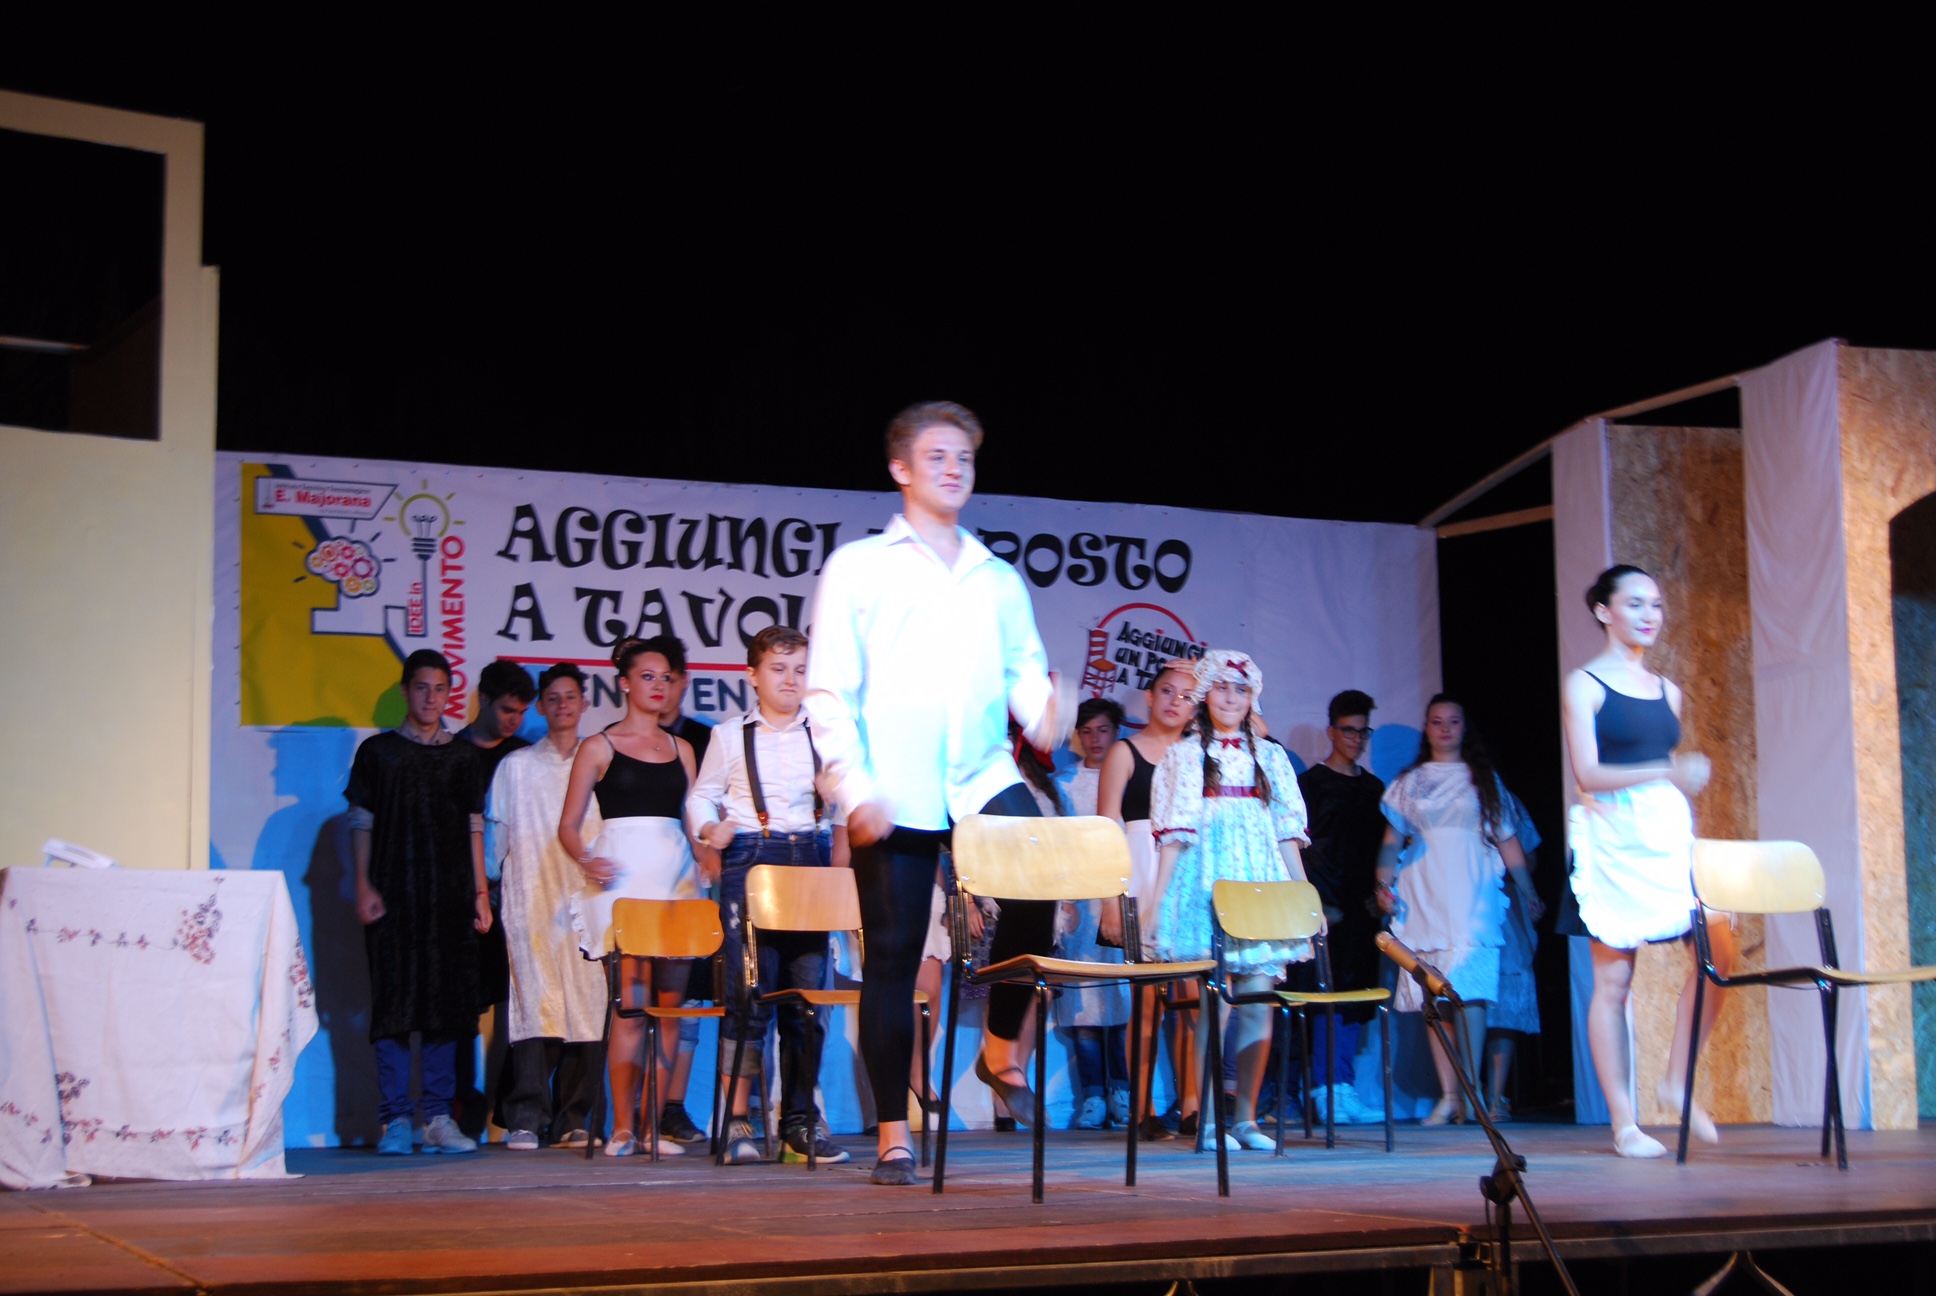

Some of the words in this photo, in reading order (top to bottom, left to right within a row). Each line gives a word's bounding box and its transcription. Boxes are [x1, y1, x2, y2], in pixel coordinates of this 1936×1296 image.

[296, 490, 372, 509] Majorana
[496, 503, 842, 578] AGGIUNGI
[441, 535, 467, 720] MOVIMENTO
[496, 582, 555, 642] A
[574, 586, 813, 648] TAVOL
[1115, 647, 1143, 668] UN
[1116, 668, 1130, 686] A
